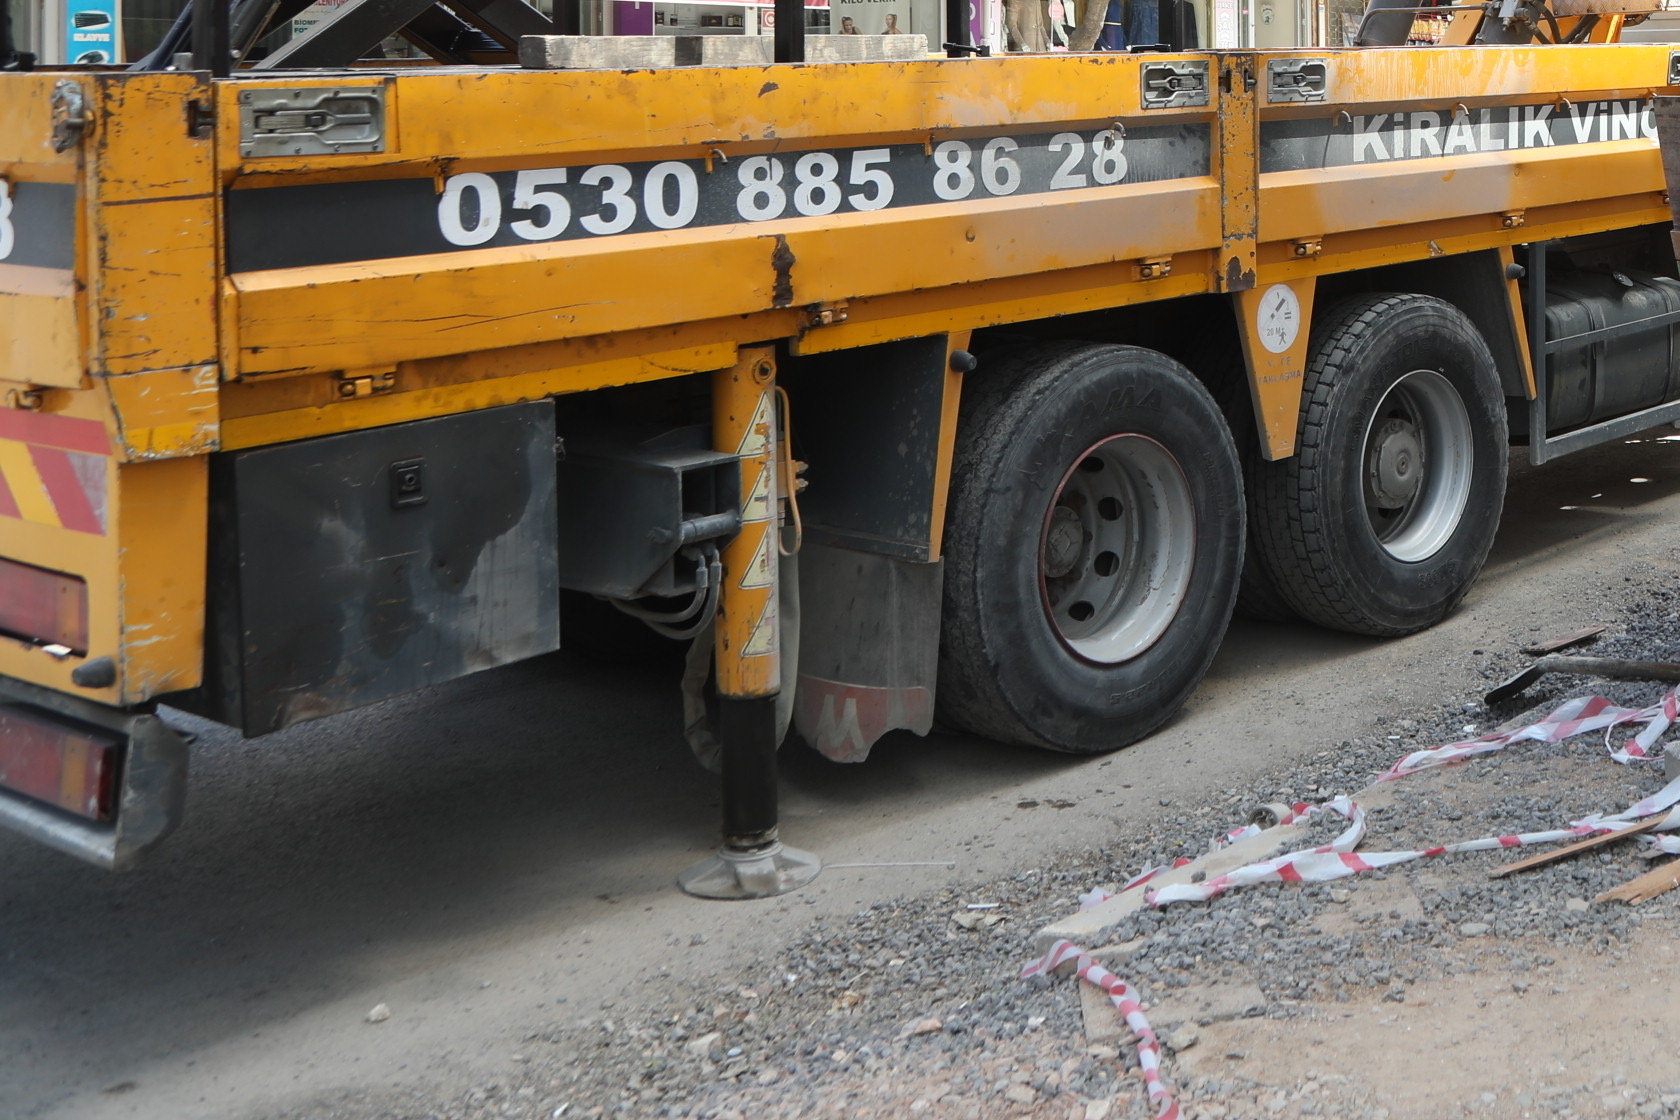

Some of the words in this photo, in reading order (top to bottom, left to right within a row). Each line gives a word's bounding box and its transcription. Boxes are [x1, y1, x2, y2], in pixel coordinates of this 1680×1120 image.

[437, 161, 698, 246] 0530
[736, 148, 894, 222] 885
[933, 136, 1021, 200] 86
[1048, 130, 1128, 190] 28
